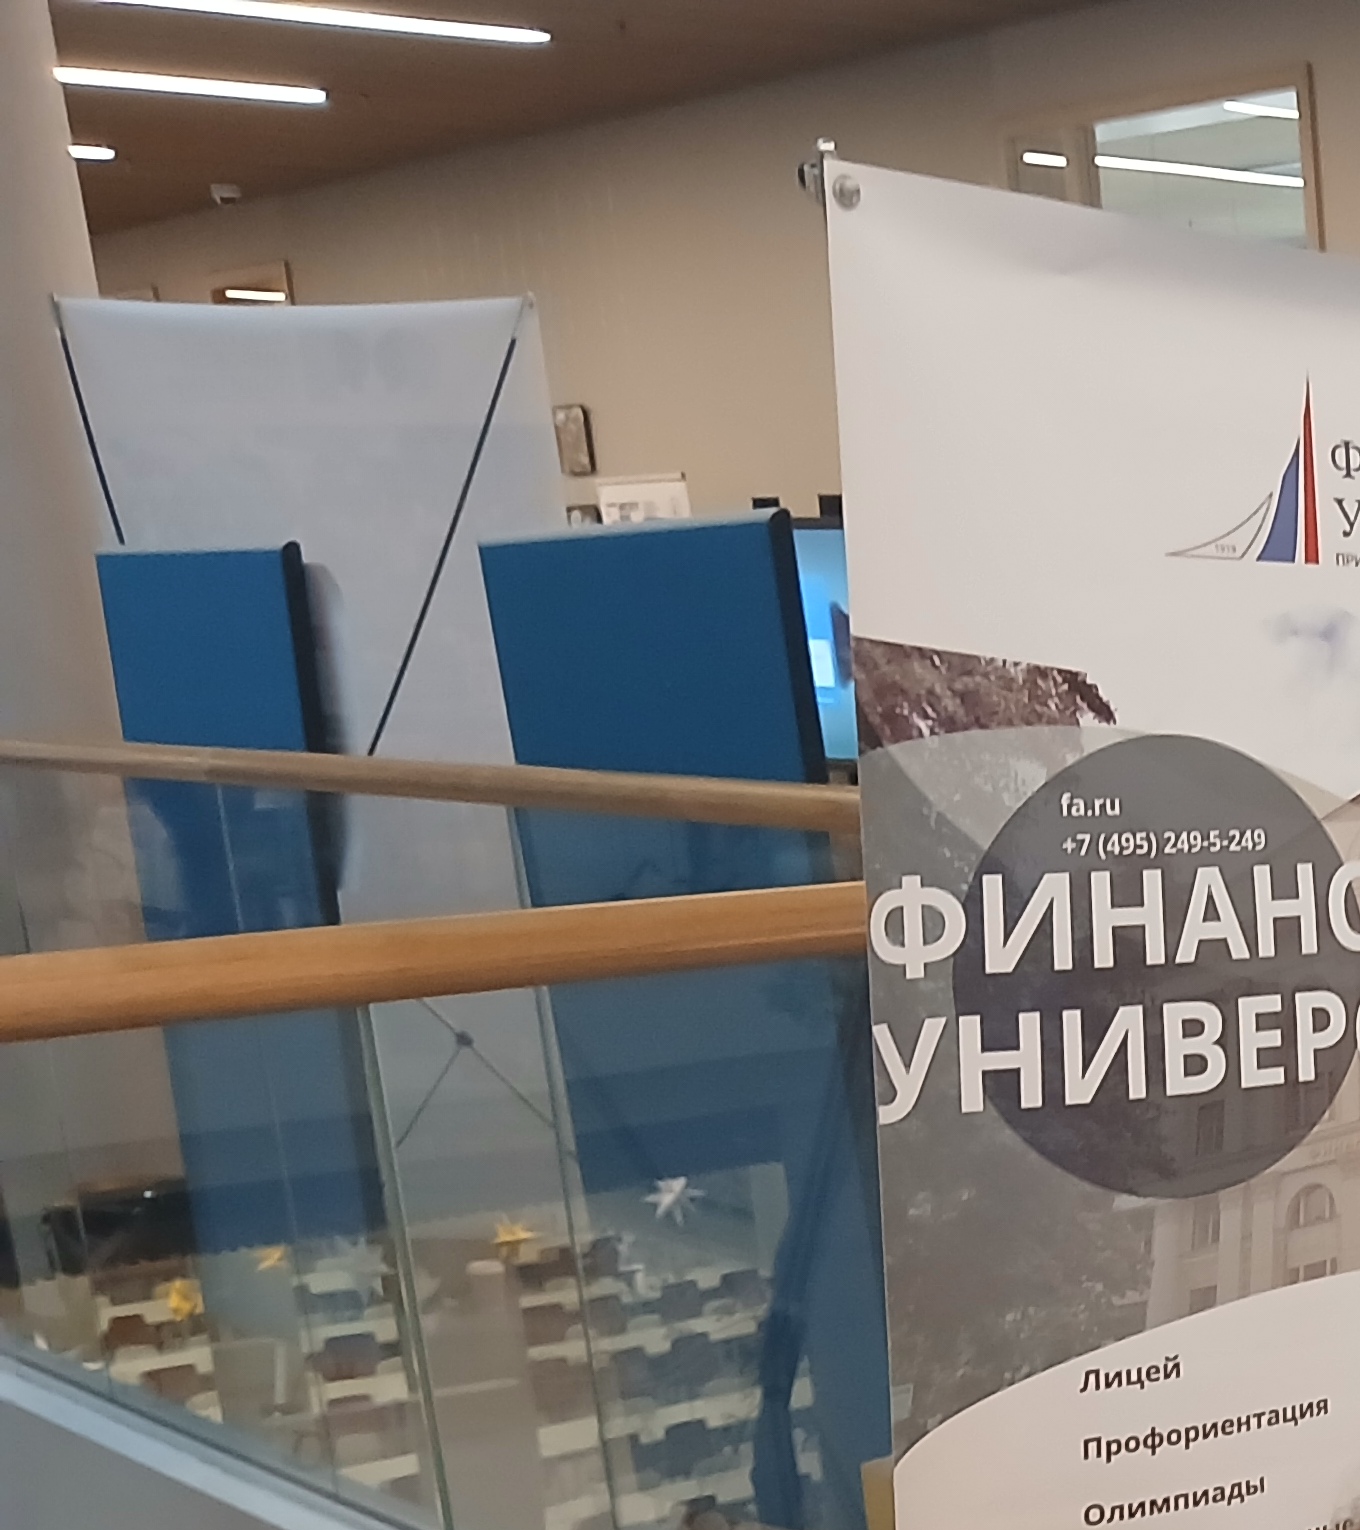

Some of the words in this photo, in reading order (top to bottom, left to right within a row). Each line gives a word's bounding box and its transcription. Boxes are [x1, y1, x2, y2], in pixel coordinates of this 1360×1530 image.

[1061, 792, 1121, 817] fa.ru
[1062, 833, 1091, 857] +7
[1098, 832, 1157, 860] (495)
[1163, 828, 1267, 854] 249-5-249
[1080, 1355, 1182, 1393] Лицей
[1082, 1398, 1330, 1463] Профориентация
[1083, 1476, 1266, 1526] Олимпиады
